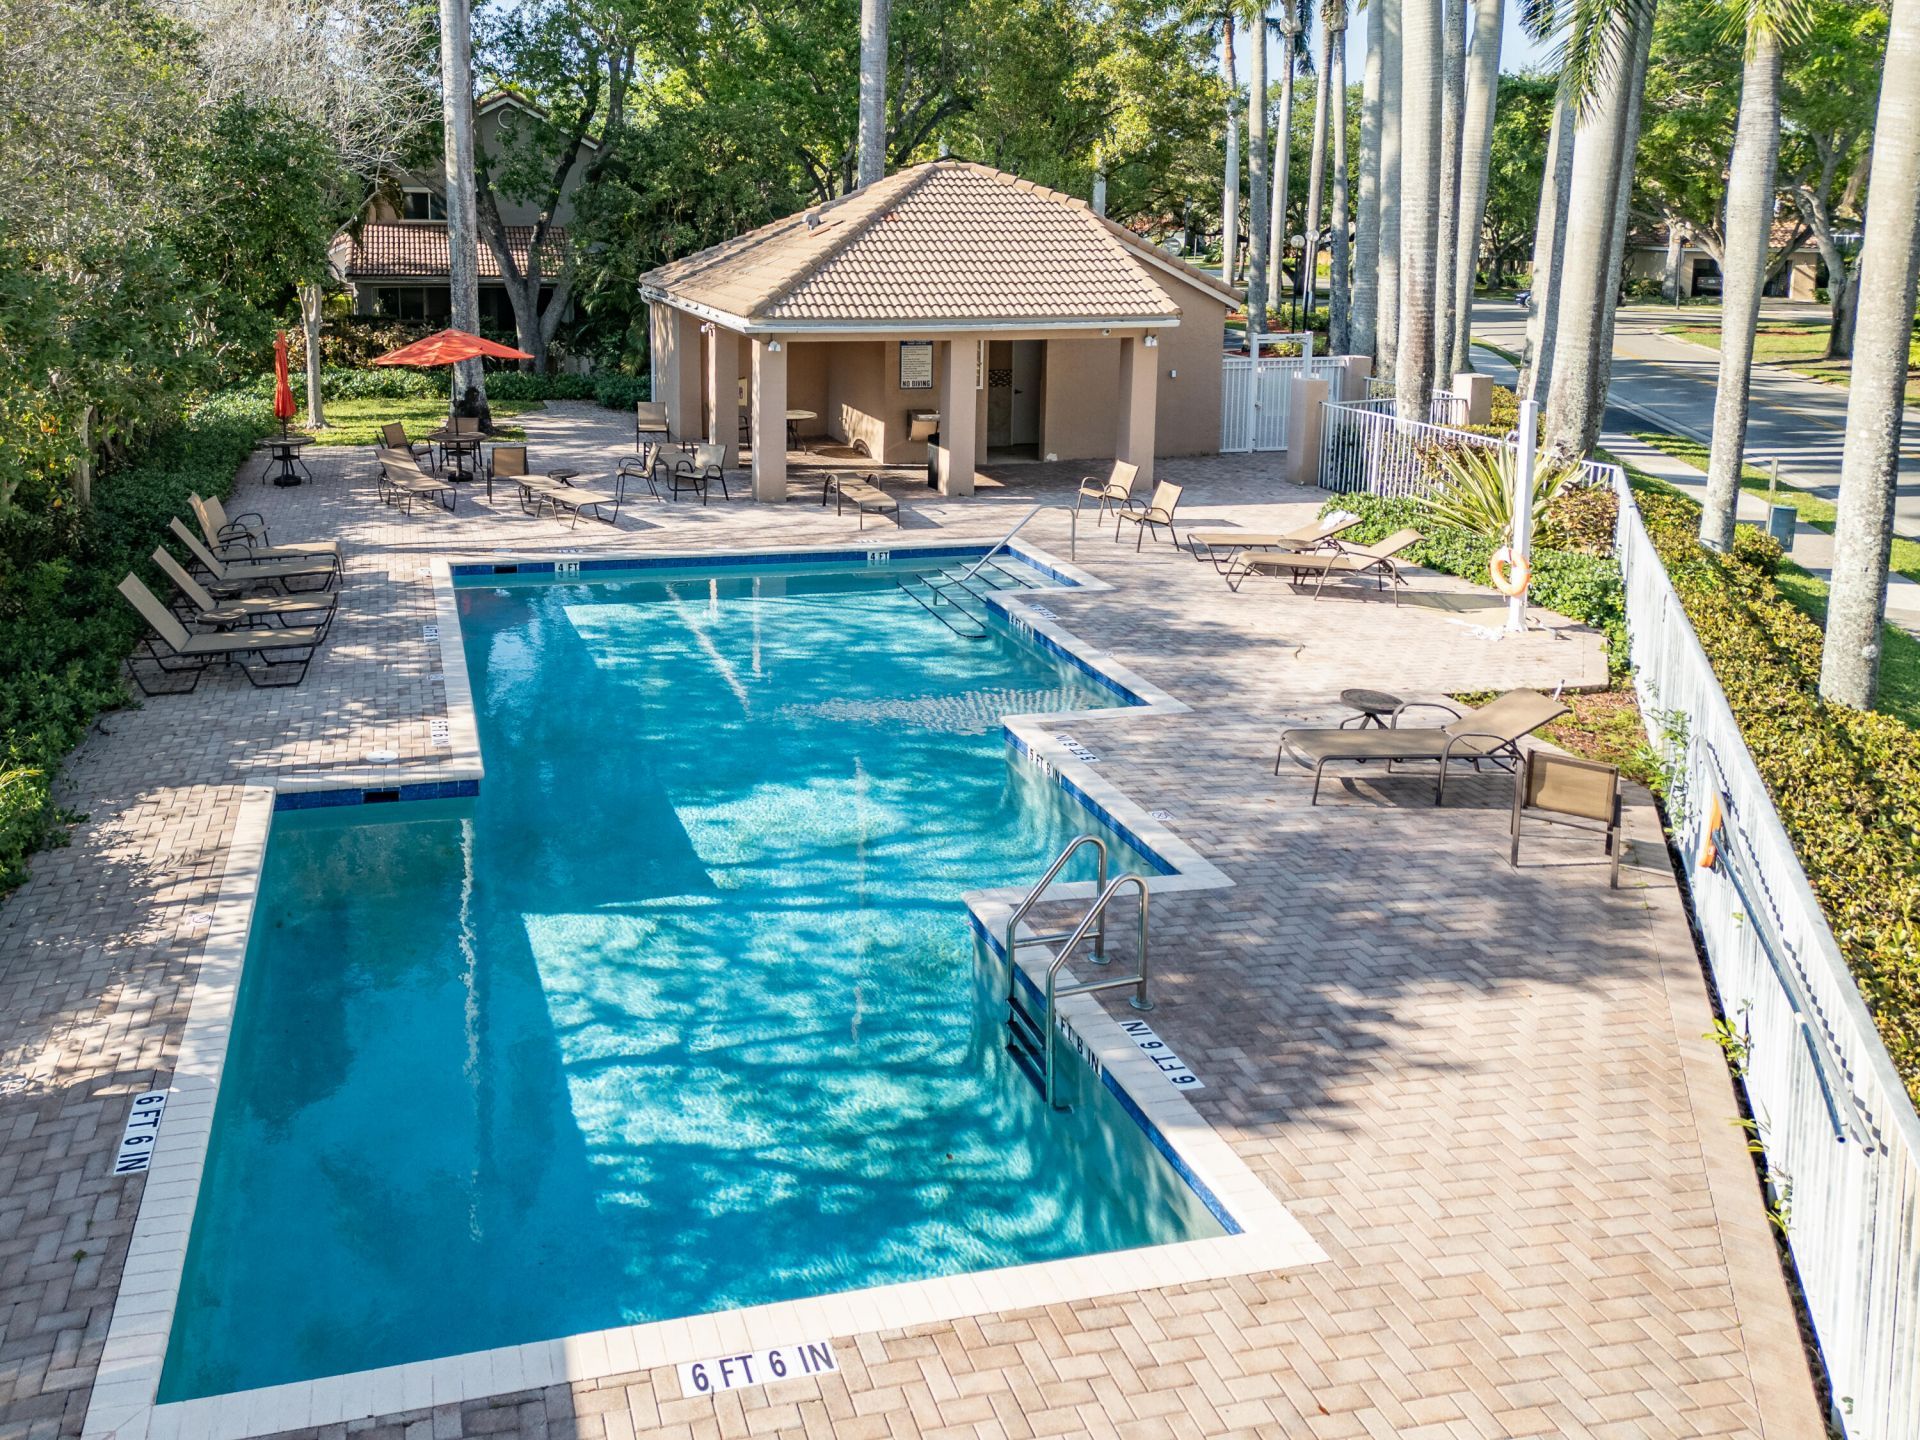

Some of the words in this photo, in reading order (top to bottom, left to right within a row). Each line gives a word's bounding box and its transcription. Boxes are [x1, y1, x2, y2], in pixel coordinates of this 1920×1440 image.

[879, 551, 889, 561] FT
[558, 563, 564, 571] 4
[568, 563, 578, 571] FT
[1069, 748, 1092, 756] FT
[1029, 748, 1034, 761] 5
[1036, 754, 1044, 769] FT
[1053, 767, 1060, 783] IN
[1121, 1021, 1153, 1037] IN
[1060, 1015, 1072, 1041] FT
[1077, 1035, 1083, 1055] 6
[1088, 1047, 1099, 1075] IN
[1140, 1041, 1164, 1050] 6
[1150, 1055, 1186, 1072] FT
[1171, 1075, 1196, 1085] 6
[135, 1095, 164, 1105] 6
[128, 1108, 162, 1128] FT
[124, 1135, 154, 1146] 6
[115, 1151, 151, 1173] IN
[691, 1363, 710, 1392] 6
[718, 1354, 754, 1388] FT
[768, 1350, 787, 1378] 6
[797, 1342, 835, 1374] IN
